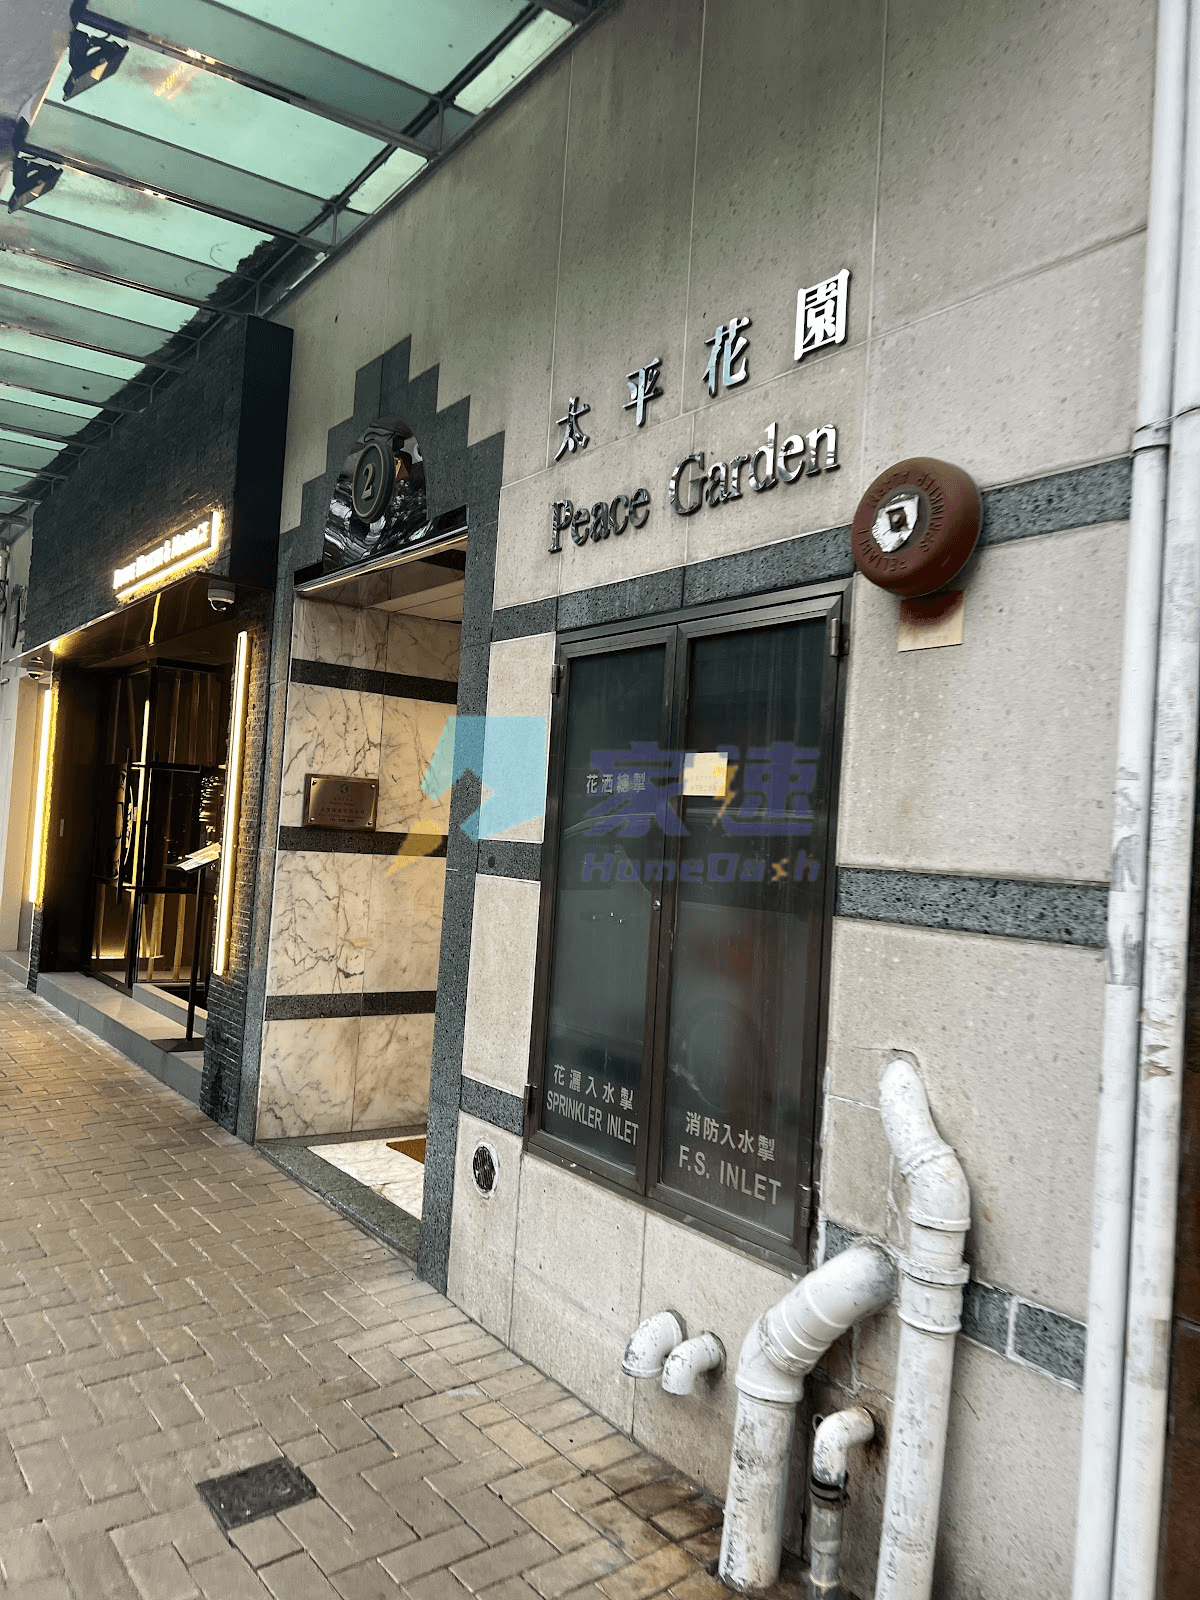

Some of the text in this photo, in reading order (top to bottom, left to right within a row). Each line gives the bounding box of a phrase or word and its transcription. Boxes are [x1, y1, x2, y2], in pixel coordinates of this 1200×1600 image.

[554, 268, 851, 462] 太平花園
[361, 463, 375, 500] 2
[548, 421, 841, 553] Peace Garden
[546, 1089, 639, 1145] SPRINKLER INLET
[685, 1110, 775, 1161] 消防入水掣
[679, 1144, 782, 1205] F.S. INLET
